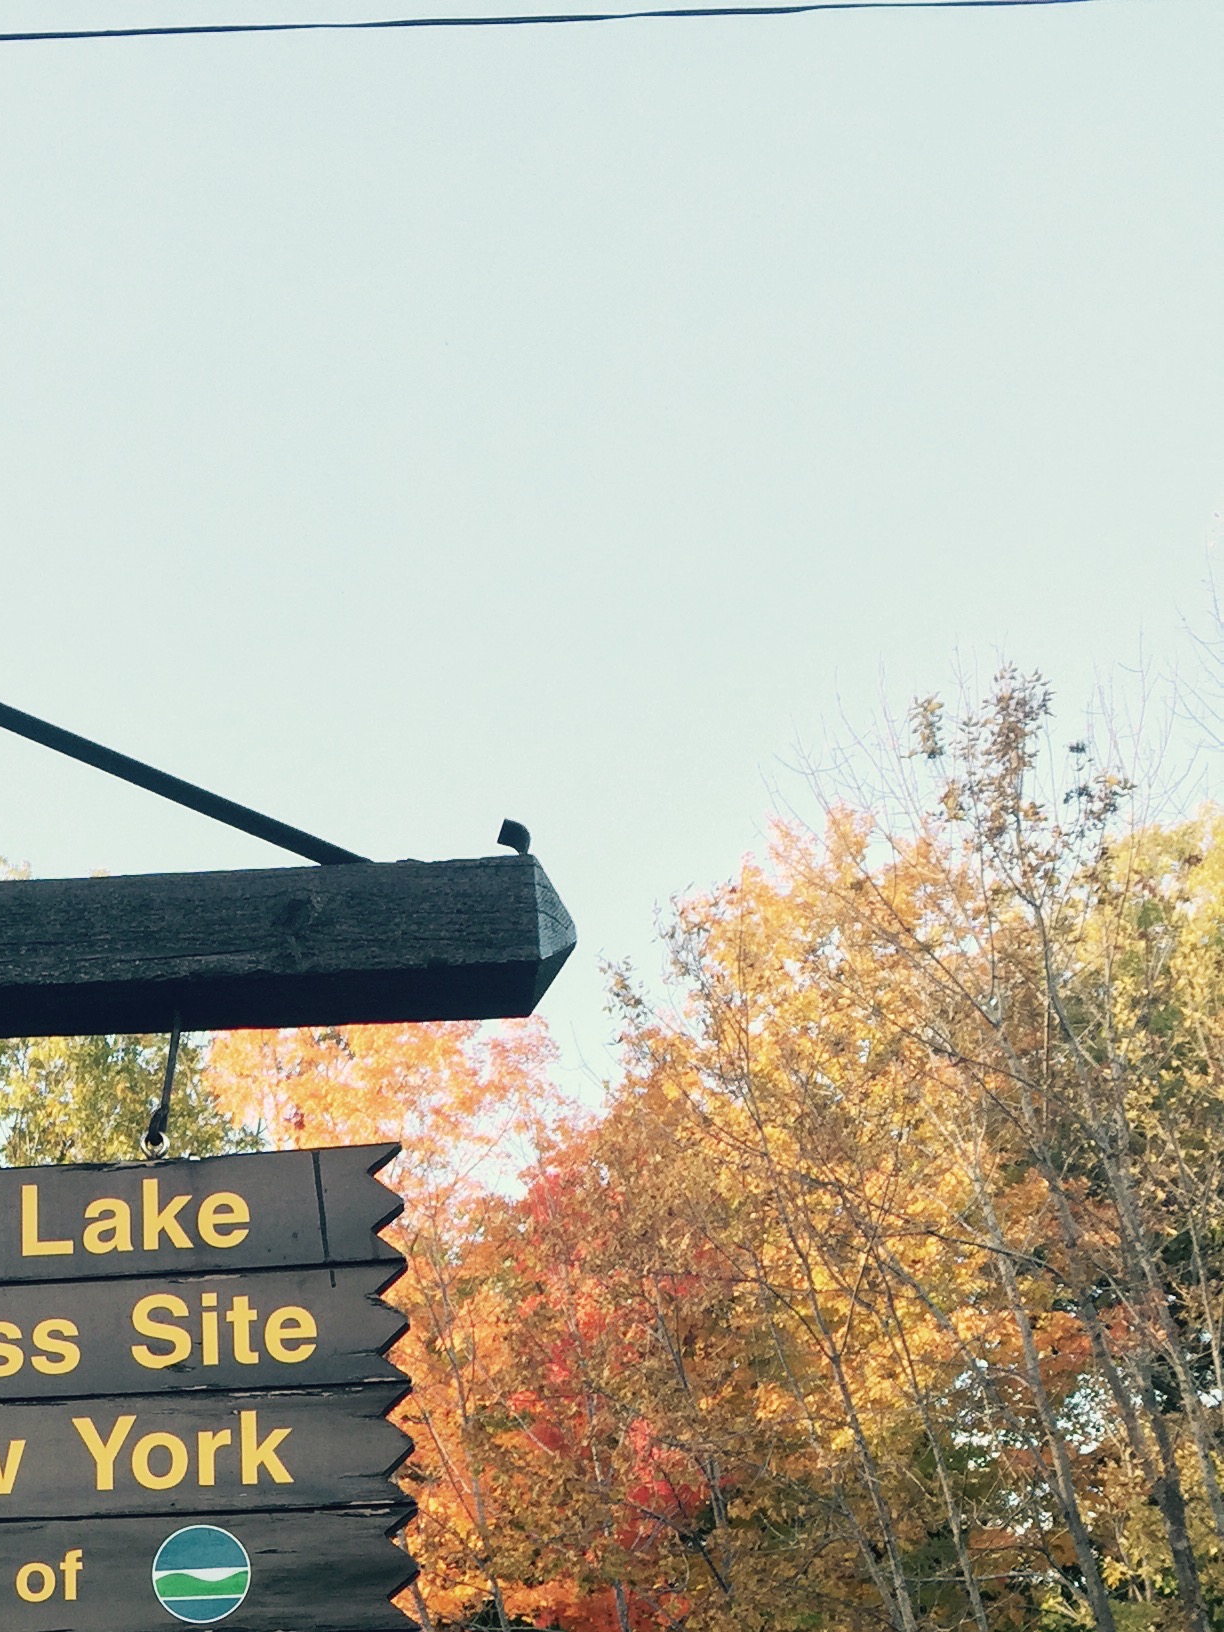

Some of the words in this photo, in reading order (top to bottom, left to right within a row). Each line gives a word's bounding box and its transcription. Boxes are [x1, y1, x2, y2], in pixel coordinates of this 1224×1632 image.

[21, 1178, 250, 1257] Lake
[131, 1291, 318, 1370] Site
[71, 1410, 293, 1491] York
[15, 1549, 83, 1603] of
